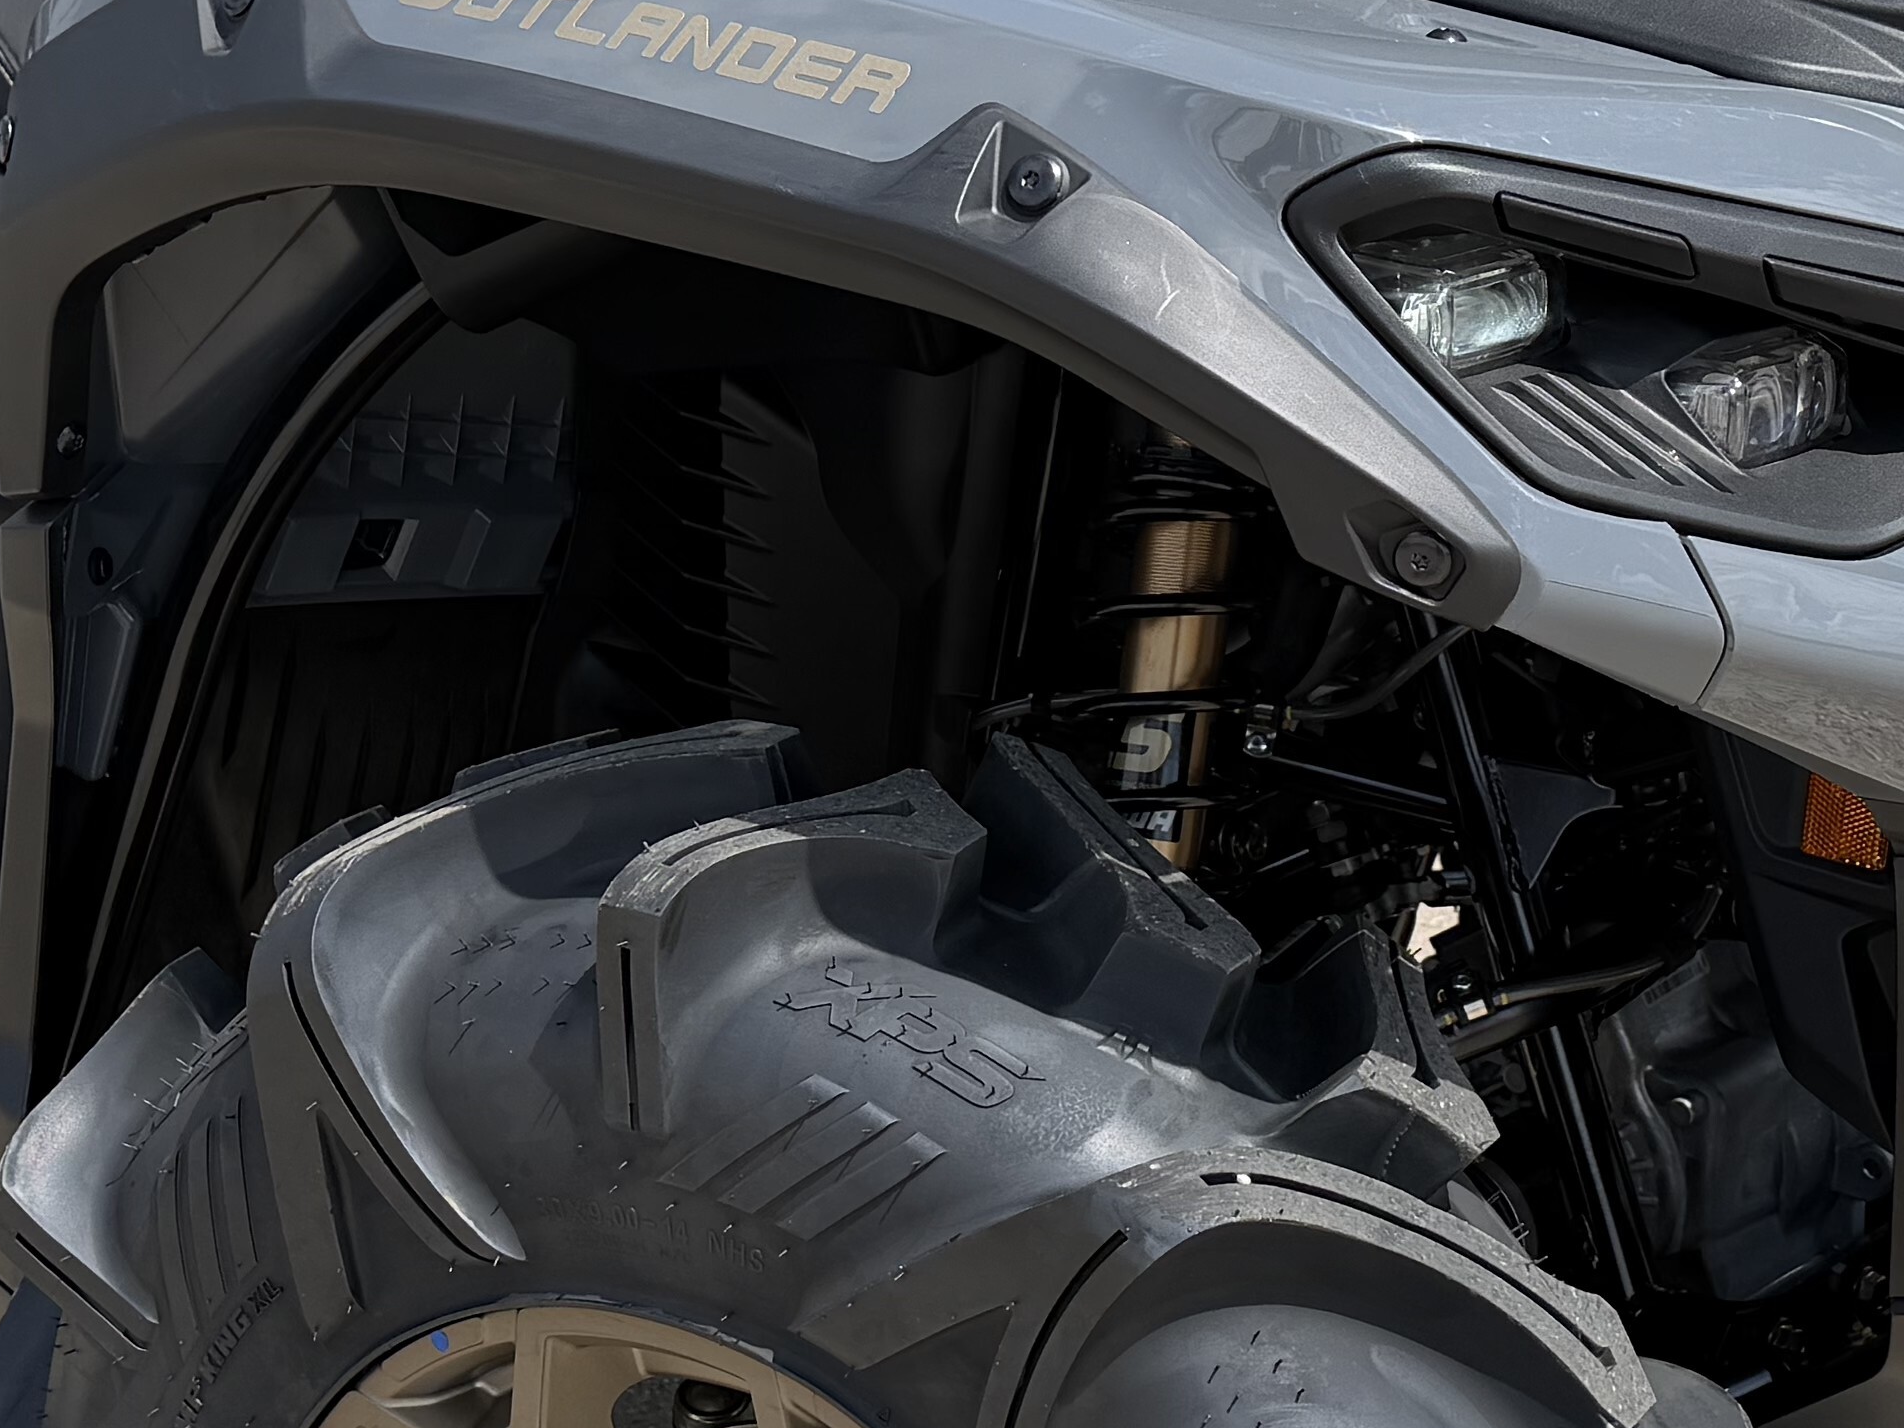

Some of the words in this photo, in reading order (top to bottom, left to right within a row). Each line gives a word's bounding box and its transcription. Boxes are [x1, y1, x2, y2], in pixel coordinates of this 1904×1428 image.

[773, 955, 1046, 1108] XPS
[700, 1228, 769, 1274] NHS
[193, 1304, 256, 1384] KING
[242, 1273, 285, 1320] XL
